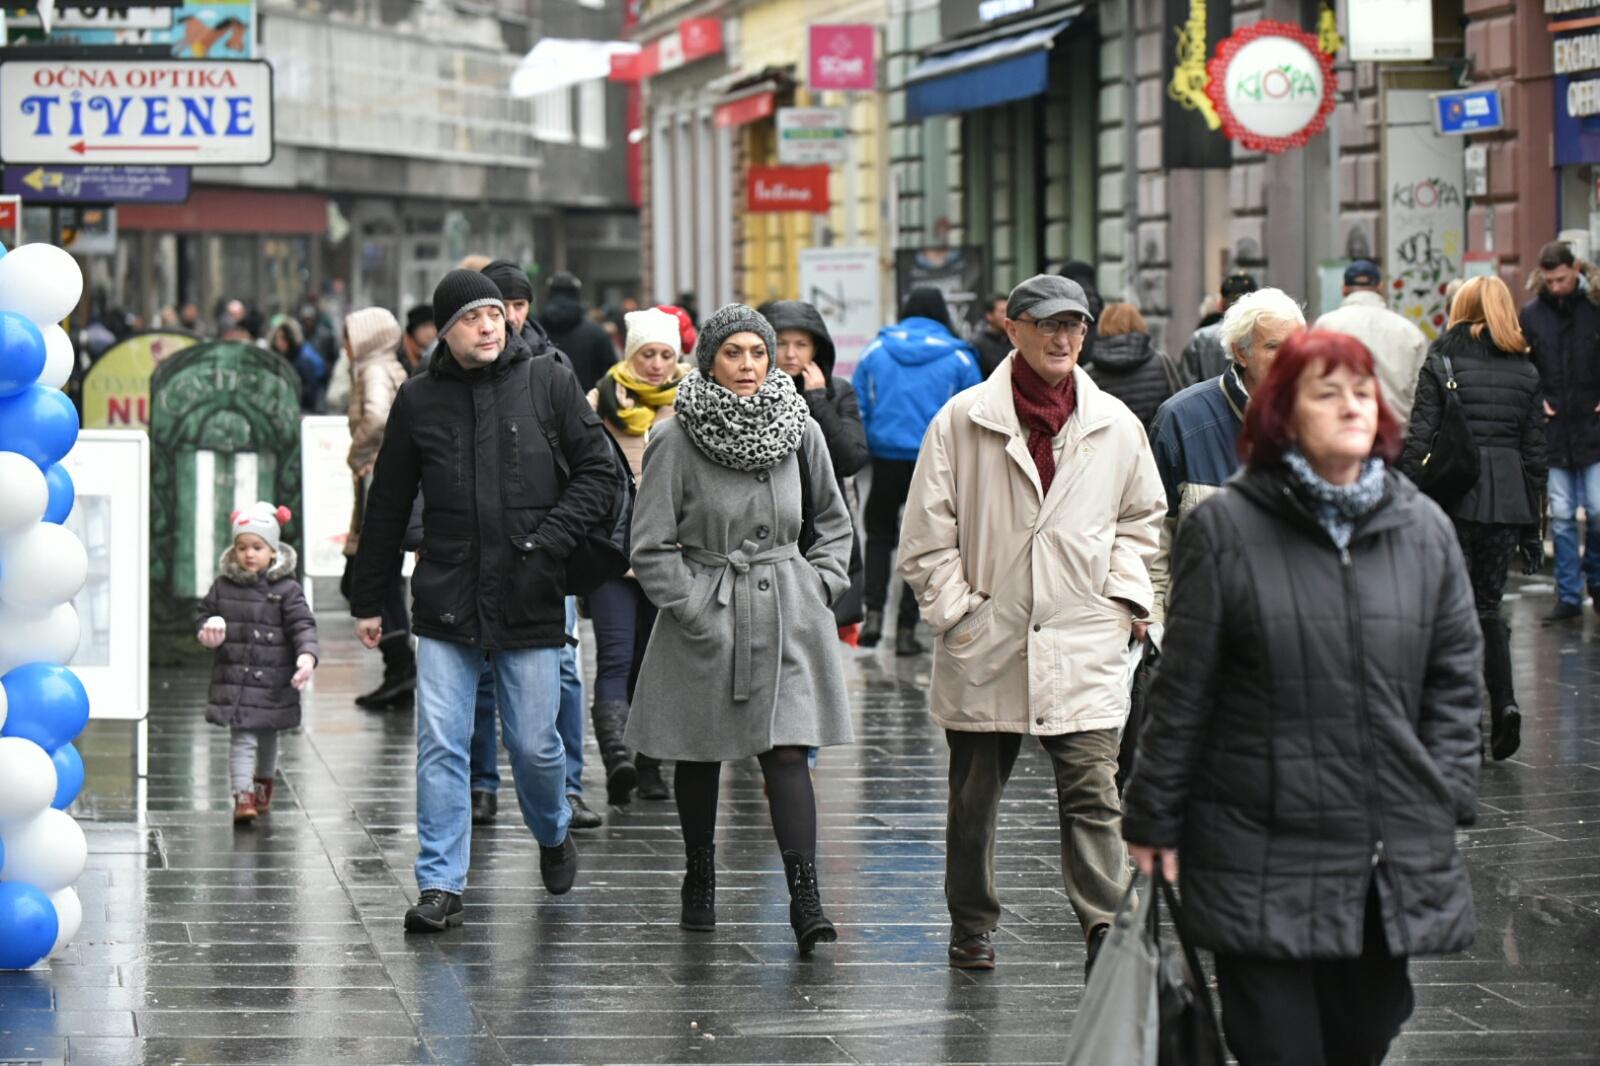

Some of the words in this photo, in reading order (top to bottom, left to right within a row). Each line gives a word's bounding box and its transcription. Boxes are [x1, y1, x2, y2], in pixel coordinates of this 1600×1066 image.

[1554, 33, 1600, 74] EXCHA
[34, 66, 117, 88] OČNA
[126, 68, 237, 88] OPTIKA
